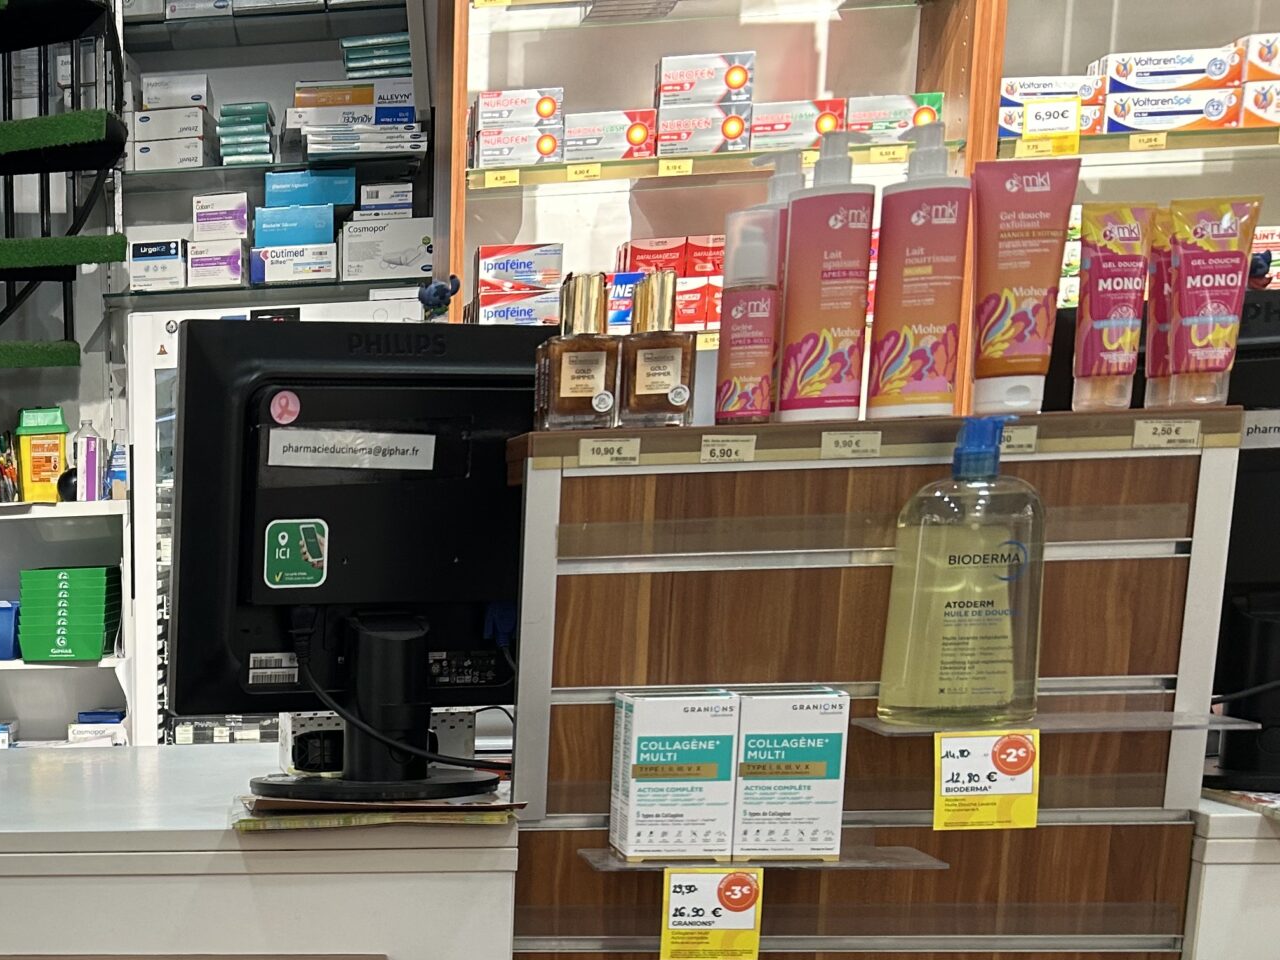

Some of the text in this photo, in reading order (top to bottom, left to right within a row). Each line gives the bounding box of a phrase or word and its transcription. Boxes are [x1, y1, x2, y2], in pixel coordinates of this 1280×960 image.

[664, 69, 715, 80] NUROFEN
[1020, 80, 1053, 90] Voltaren
[378, 93, 411, 102] ALLEVYN
[483, 98, 528, 108] NUROFEN
[1035, 109, 1069, 122] 6,90€
[661, 119, 712, 130] NUROFEN
[1024, 172, 1050, 187] mkl
[932, 202, 958, 218] mkl
[1000, 211, 1051, 221] Gel douche
[348, 224, 387, 234] Cosmopor
[1117, 224, 1141, 239] mkl
[270, 249, 305, 259] Cutimed
[823, 250, 842, 259] Lait
[906, 246, 925, 256] Lait
[483, 258, 535, 274] Ipraféine
[1208, 257, 1241, 265] DOUCHE
[1187, 271, 1243, 288] MONOÏ
[483, 306, 533, 322] Ipraféine
[348, 332, 447, 355] PHILIPS
[1152, 427, 1172, 436] 2,50
[834, 440, 852, 448] 9,90
[591, 447, 615, 455] 10,90
[709, 448, 732, 458] 6,90
[275, 548, 290, 559] ICI
[948, 553, 1020, 566] BIODERMA
[945, 600, 994, 609] ATODERM
[944, 609, 983, 617] HUILE DE
[71, 728, 107, 738] Cosmopor
[640, 752, 677, 762] MULTI
[747, 750, 785, 760] MULTI
[986, 771, 998, 782] €
[712, 907, 722, 917] €
